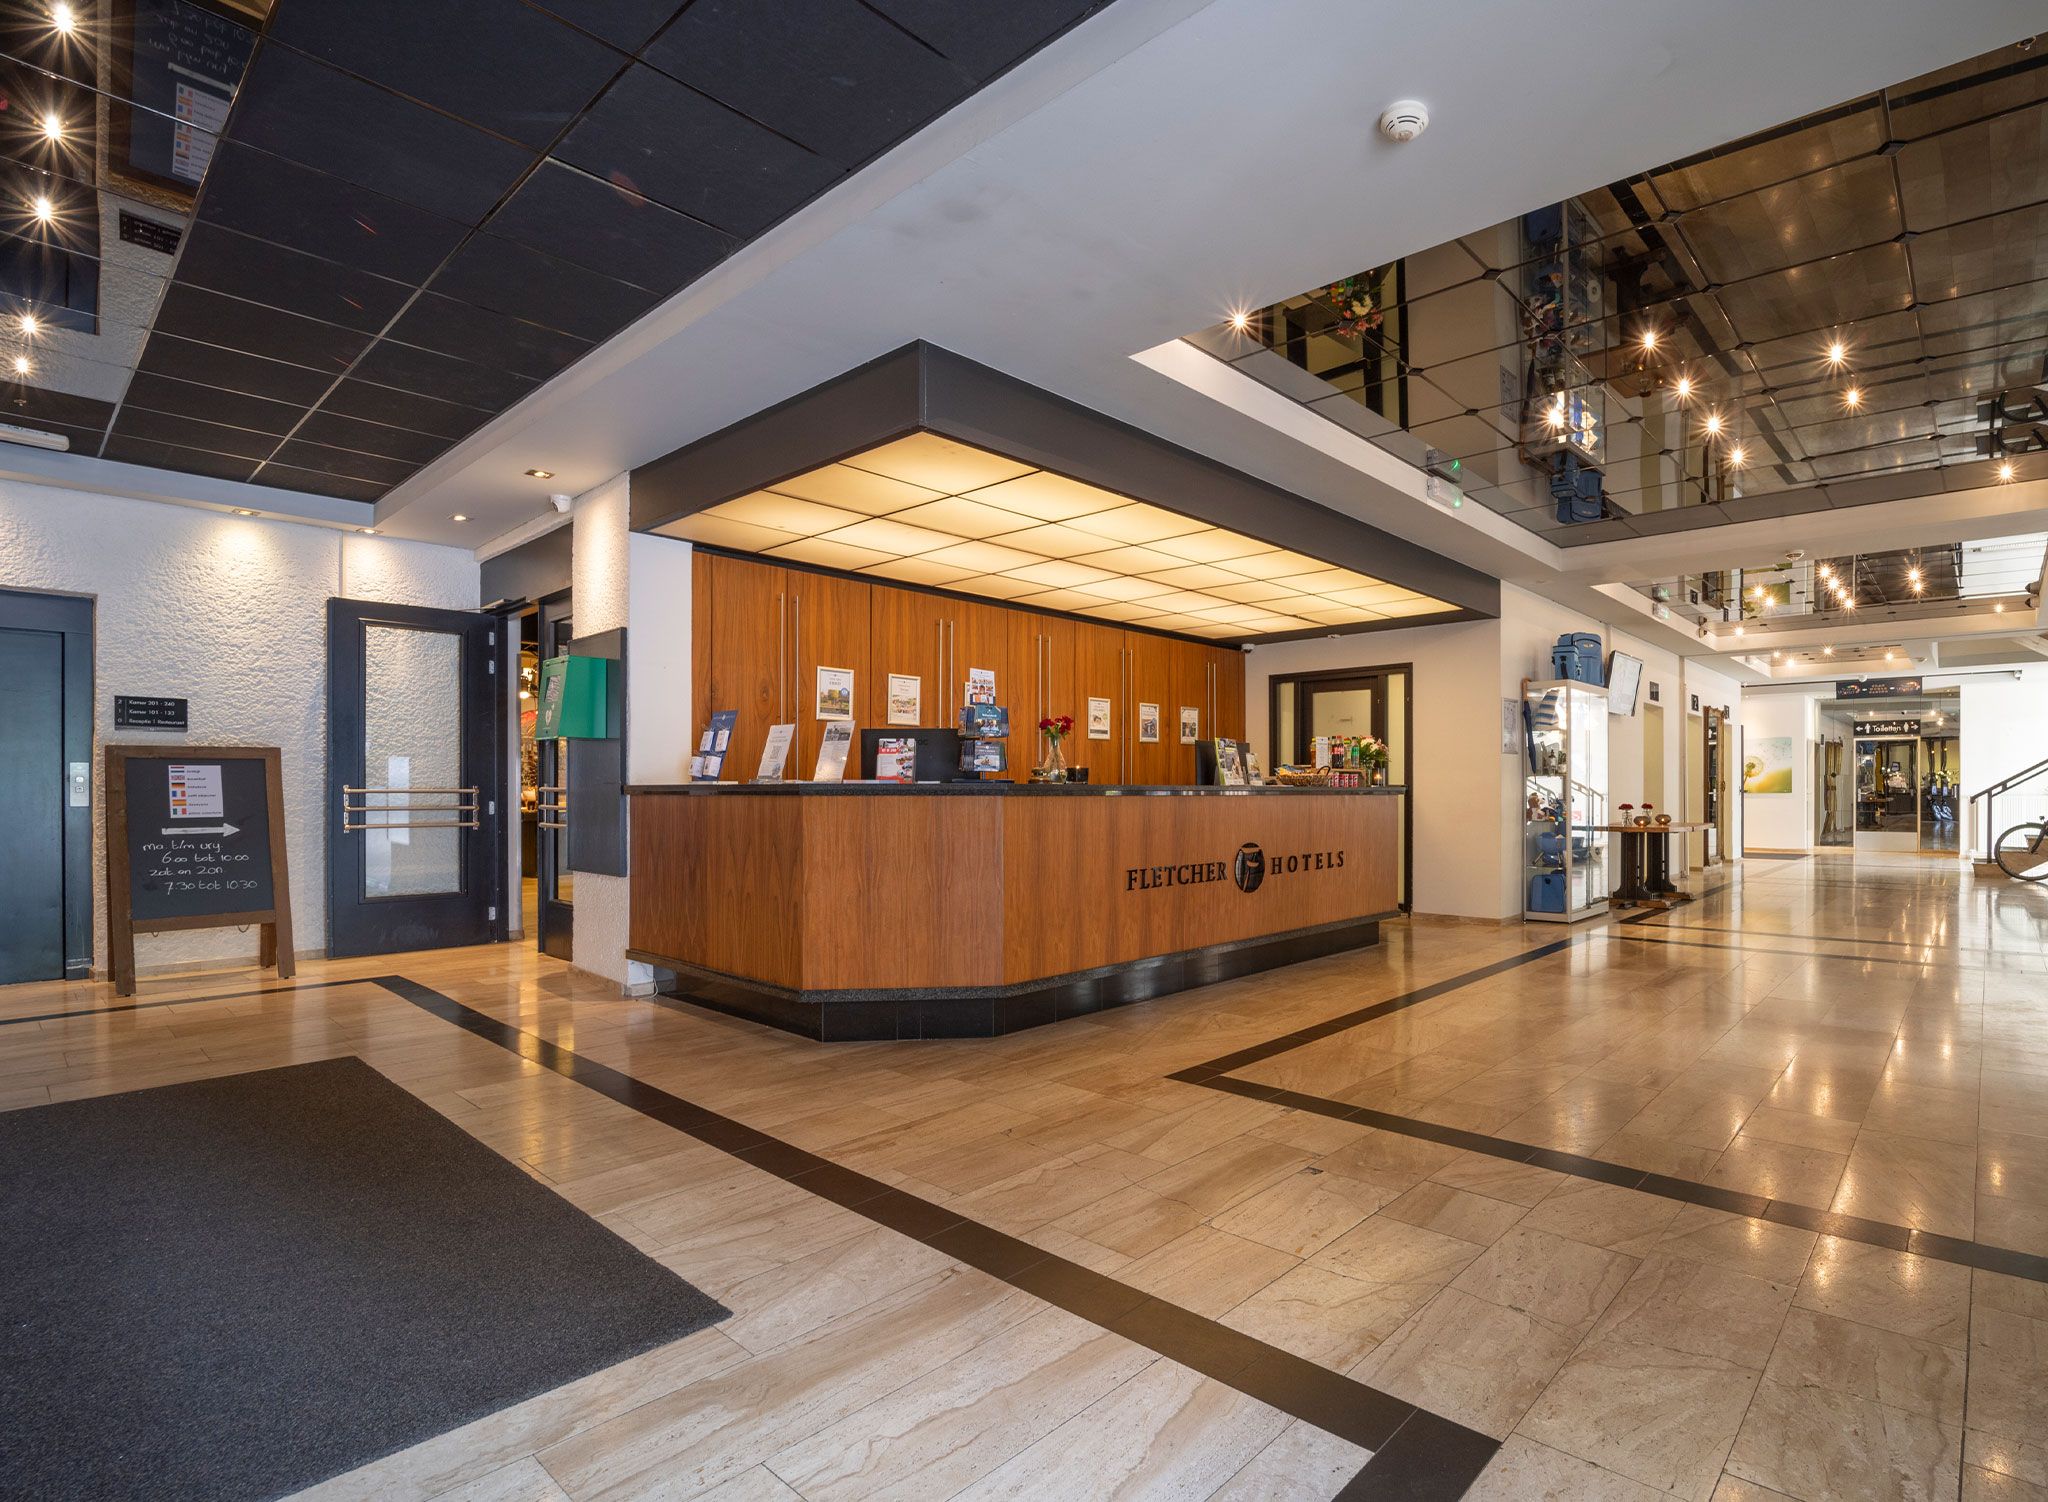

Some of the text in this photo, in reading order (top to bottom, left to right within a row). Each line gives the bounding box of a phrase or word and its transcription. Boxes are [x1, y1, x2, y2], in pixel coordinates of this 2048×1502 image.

[1872, 723, 1902, 733] Toiletten
[194, 853, 215, 863] tot
[1126, 861, 1228, 891] FLETCHER
[1270, 850, 1344, 875] HOTELS
[198, 880, 222, 890] tot
